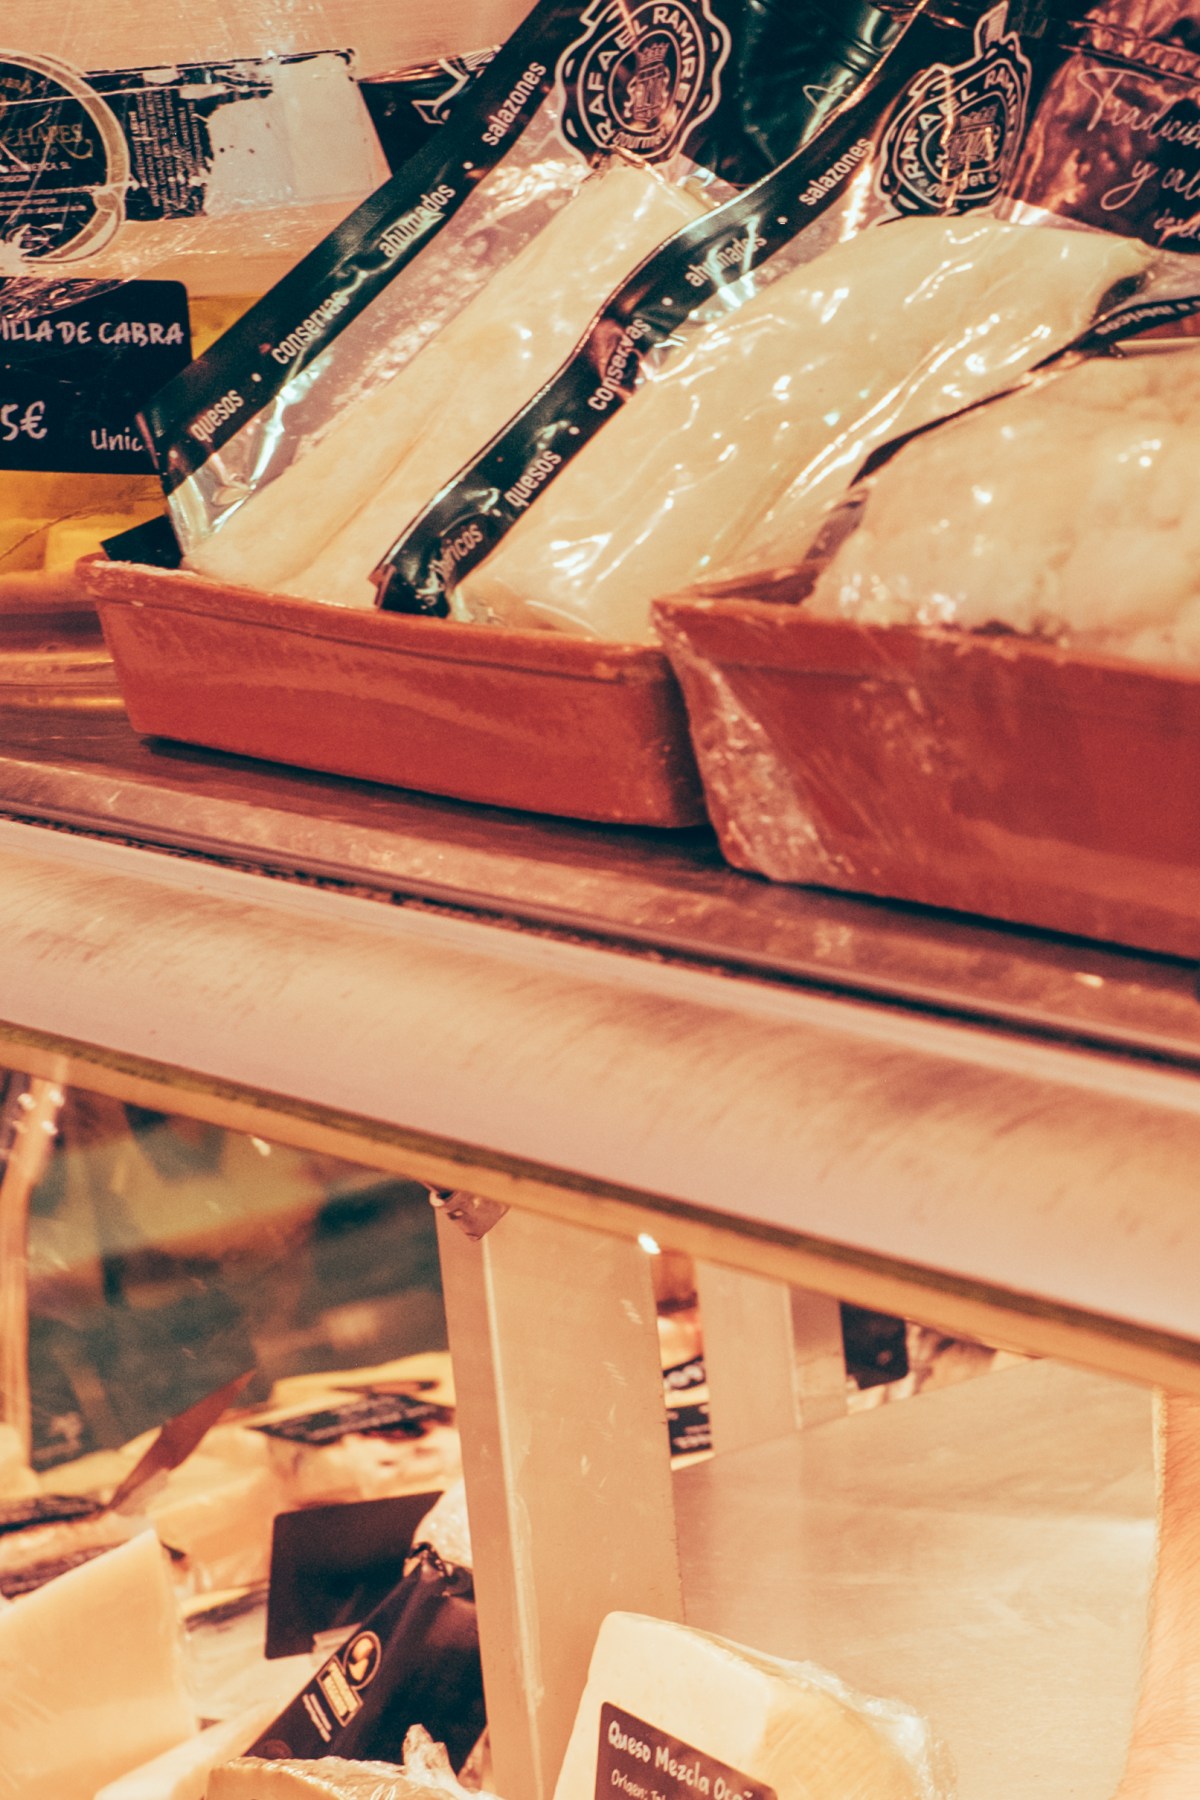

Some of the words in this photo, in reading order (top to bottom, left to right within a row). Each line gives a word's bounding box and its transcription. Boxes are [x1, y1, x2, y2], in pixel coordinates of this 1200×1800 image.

[587, 20, 648, 142] RAFAEL
[1100, 160, 1159, 211] y
[189, 387, 244, 442] quesos
[271, 290, 350, 366] conservas
[379, 183, 457, 259] ahumados
[482, 60, 547, 146] salazones
[55, 321, 93, 345] DE
[98, 322, 184, 347] CABRA
[503, 450, 562, 508] quesos
[587, 316, 652, 412] conservas
[799, 135, 874, 206] salazones
[608, 1720, 651, 1763] Queso
[655, 1746, 710, 1796] Mezcla
